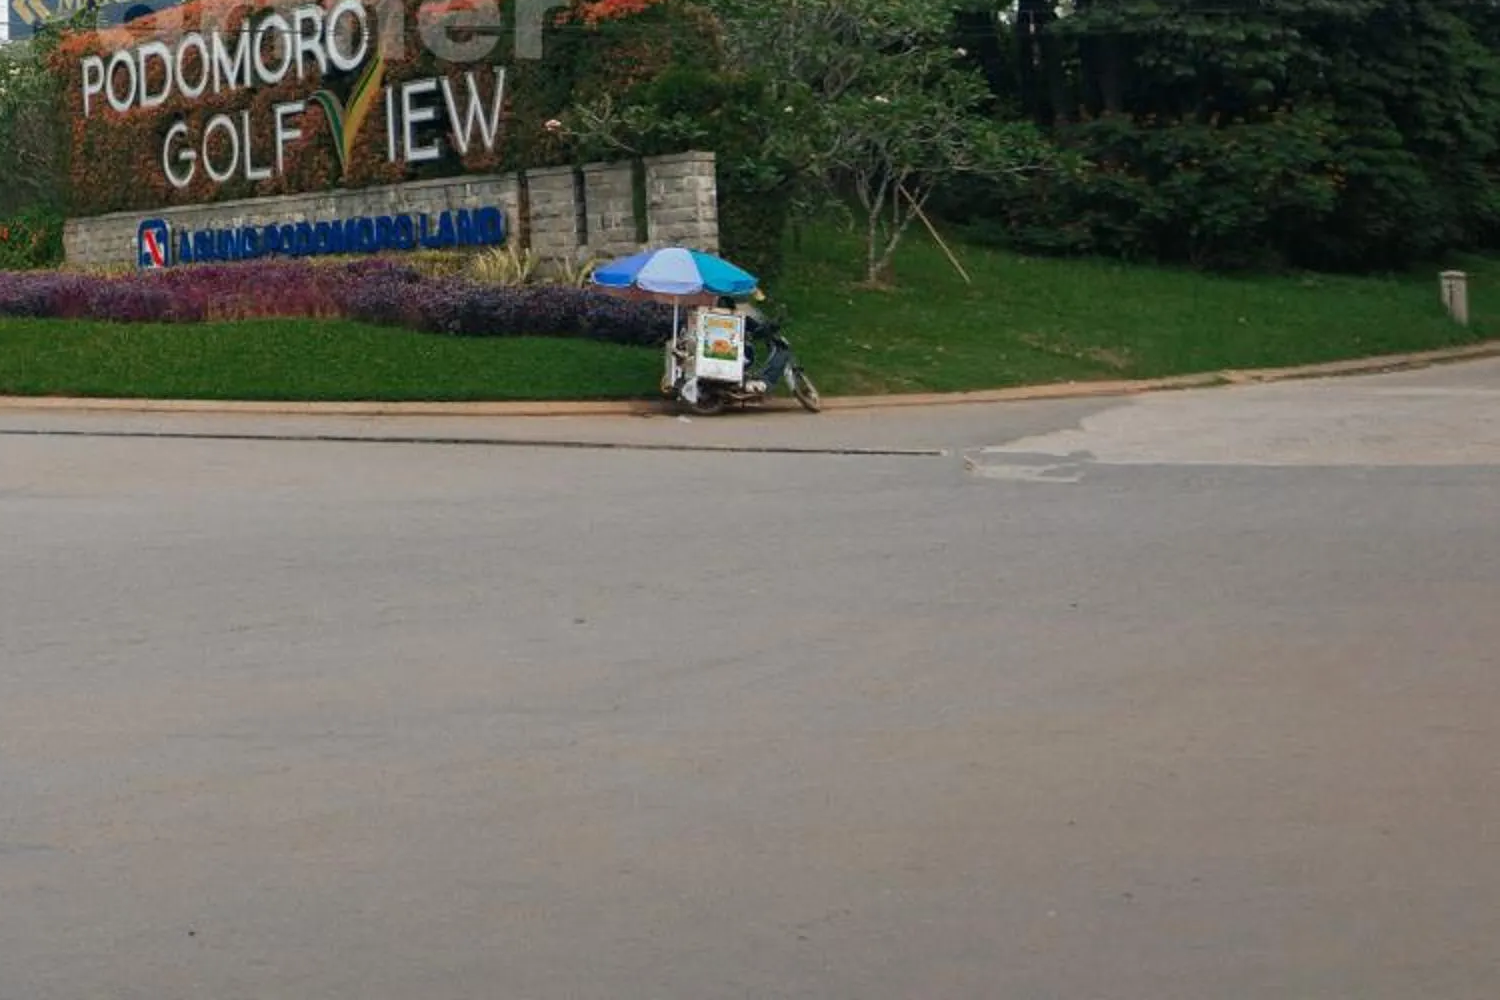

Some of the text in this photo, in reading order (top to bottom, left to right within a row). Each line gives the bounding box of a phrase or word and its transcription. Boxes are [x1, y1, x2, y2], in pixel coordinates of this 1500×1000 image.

[162, 100, 308, 188] GOLF
[263, 212, 414, 257] PODOMORO
[418, 205, 509, 248] LAND
